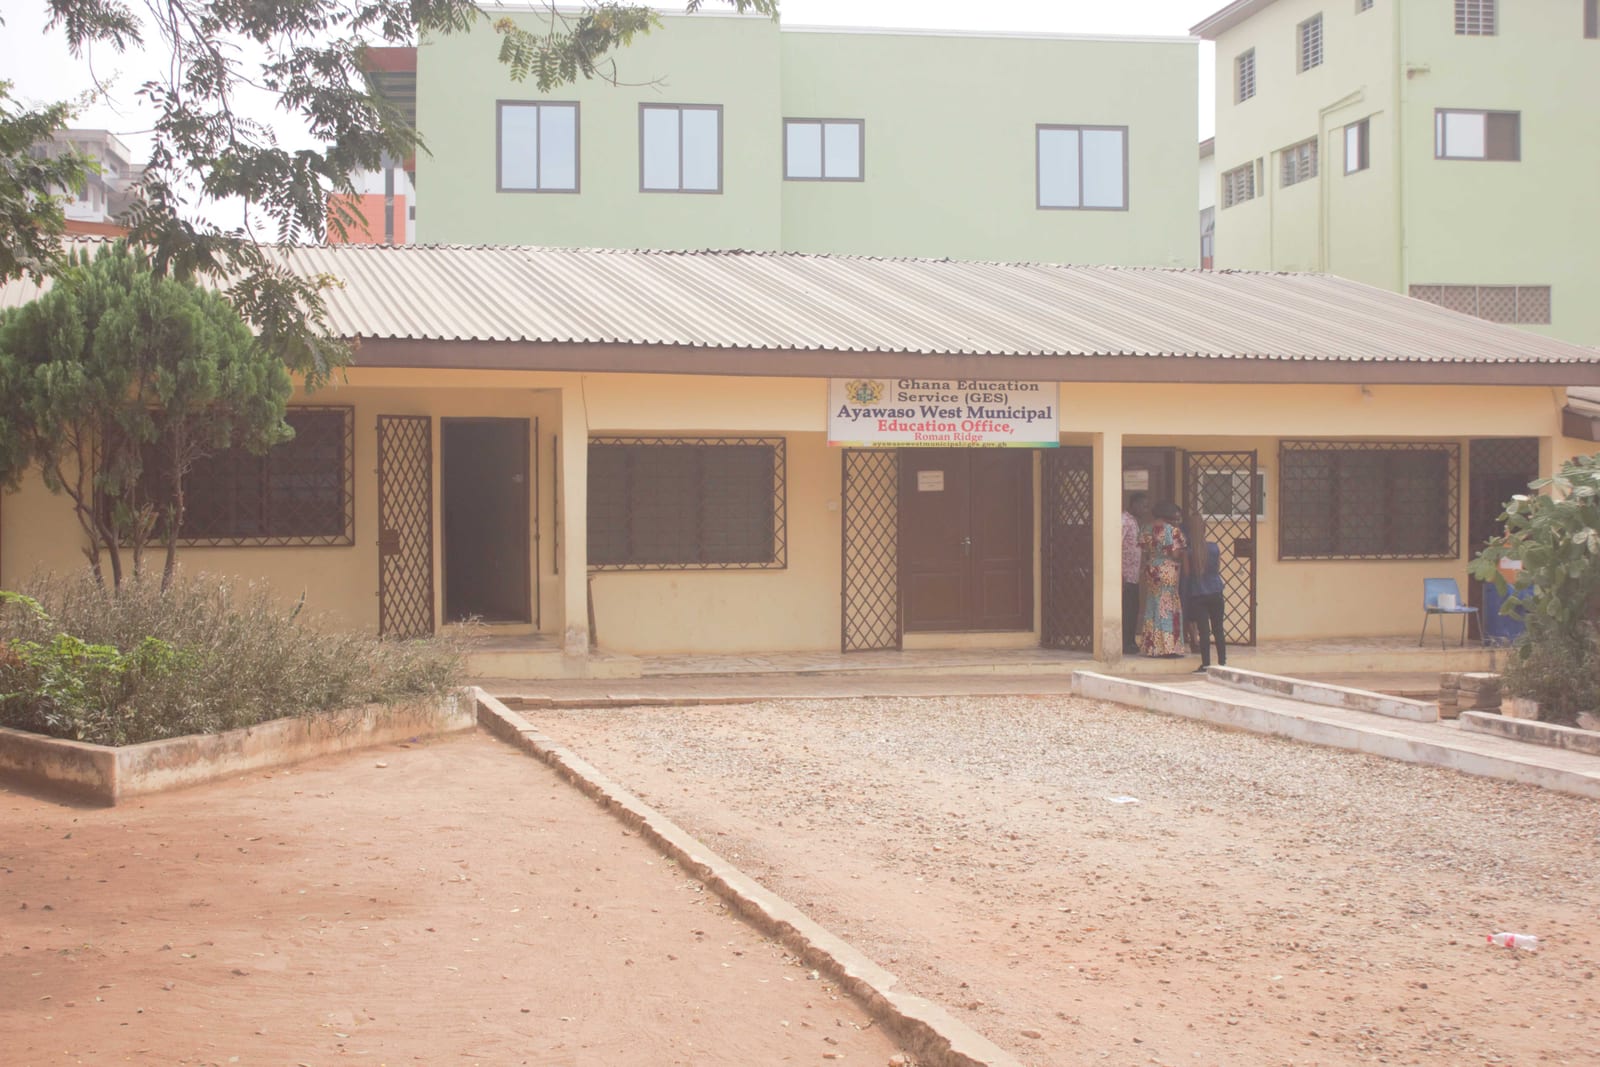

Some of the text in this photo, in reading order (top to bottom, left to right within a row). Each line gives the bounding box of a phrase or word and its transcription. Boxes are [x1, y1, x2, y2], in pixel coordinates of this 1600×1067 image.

[897, 379, 1039, 391] Ghana Education
[897, 392, 1008, 405] Service (GES)
[837, 404, 1052, 423] Ayawaso West Municipal
[878, 419, 1015, 434] Education Office,
[914, 432, 983, 443] Roman Ridge
